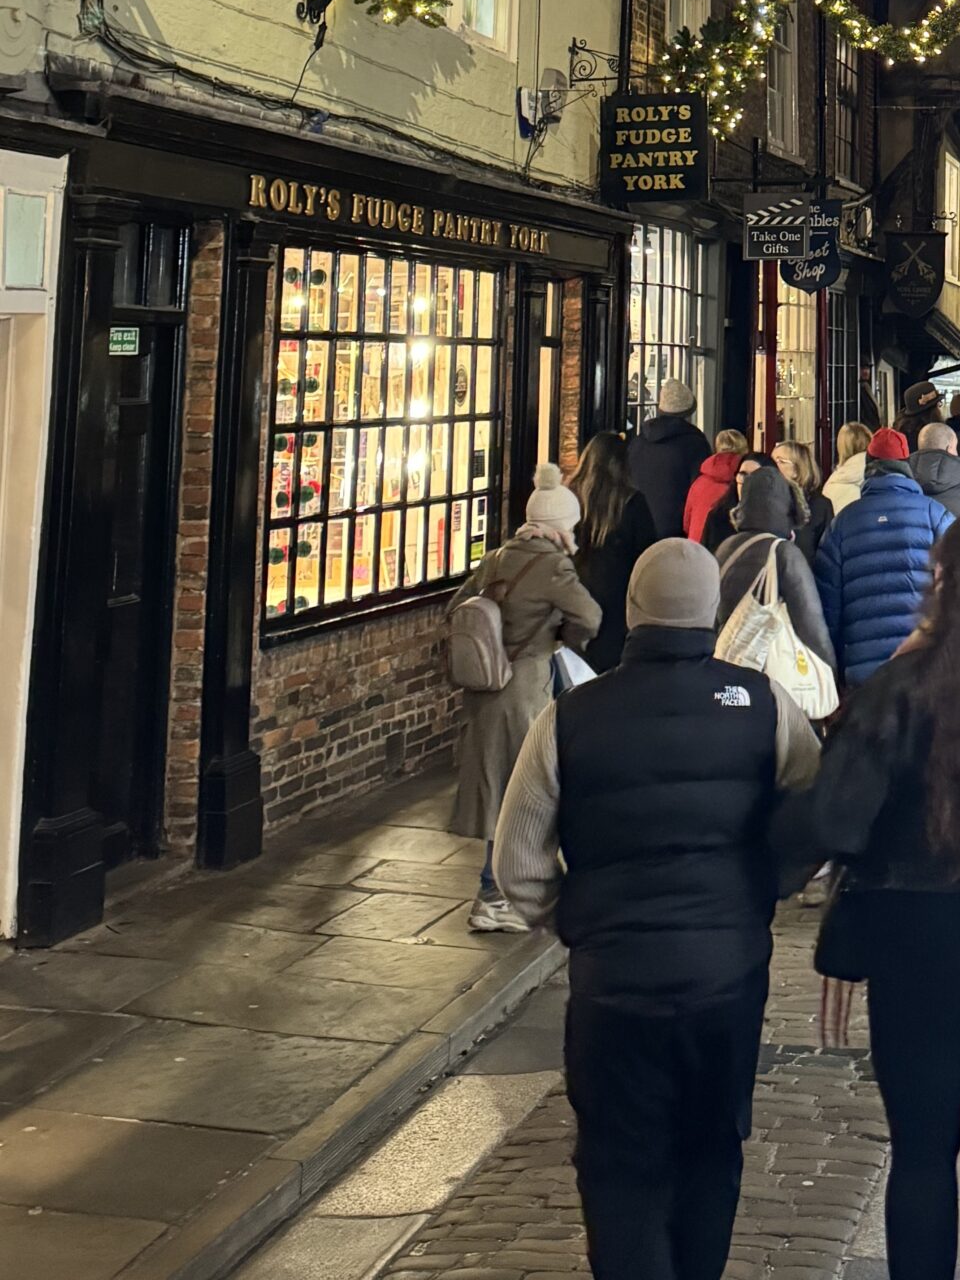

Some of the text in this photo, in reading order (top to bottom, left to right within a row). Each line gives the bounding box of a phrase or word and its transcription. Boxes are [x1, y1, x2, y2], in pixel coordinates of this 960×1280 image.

[615, 104, 692, 123] ROLY'S
[615, 127, 692, 146] FUDGE
[609, 150, 699, 169] PANTRY
[623, 172, 686, 191] YORK
[249, 173, 551, 255] ROLY'S FUDGE PANTRY YORK
[751, 230, 801, 242] Take One
[762, 243, 789, 255] Gifts
[792, 260, 826, 282] Shop
[110, 330, 136, 340] Fire exit
[122, 343, 136, 351] clear
[714, 692, 739, 700] NORTH
[724, 685, 738, 694] THE
